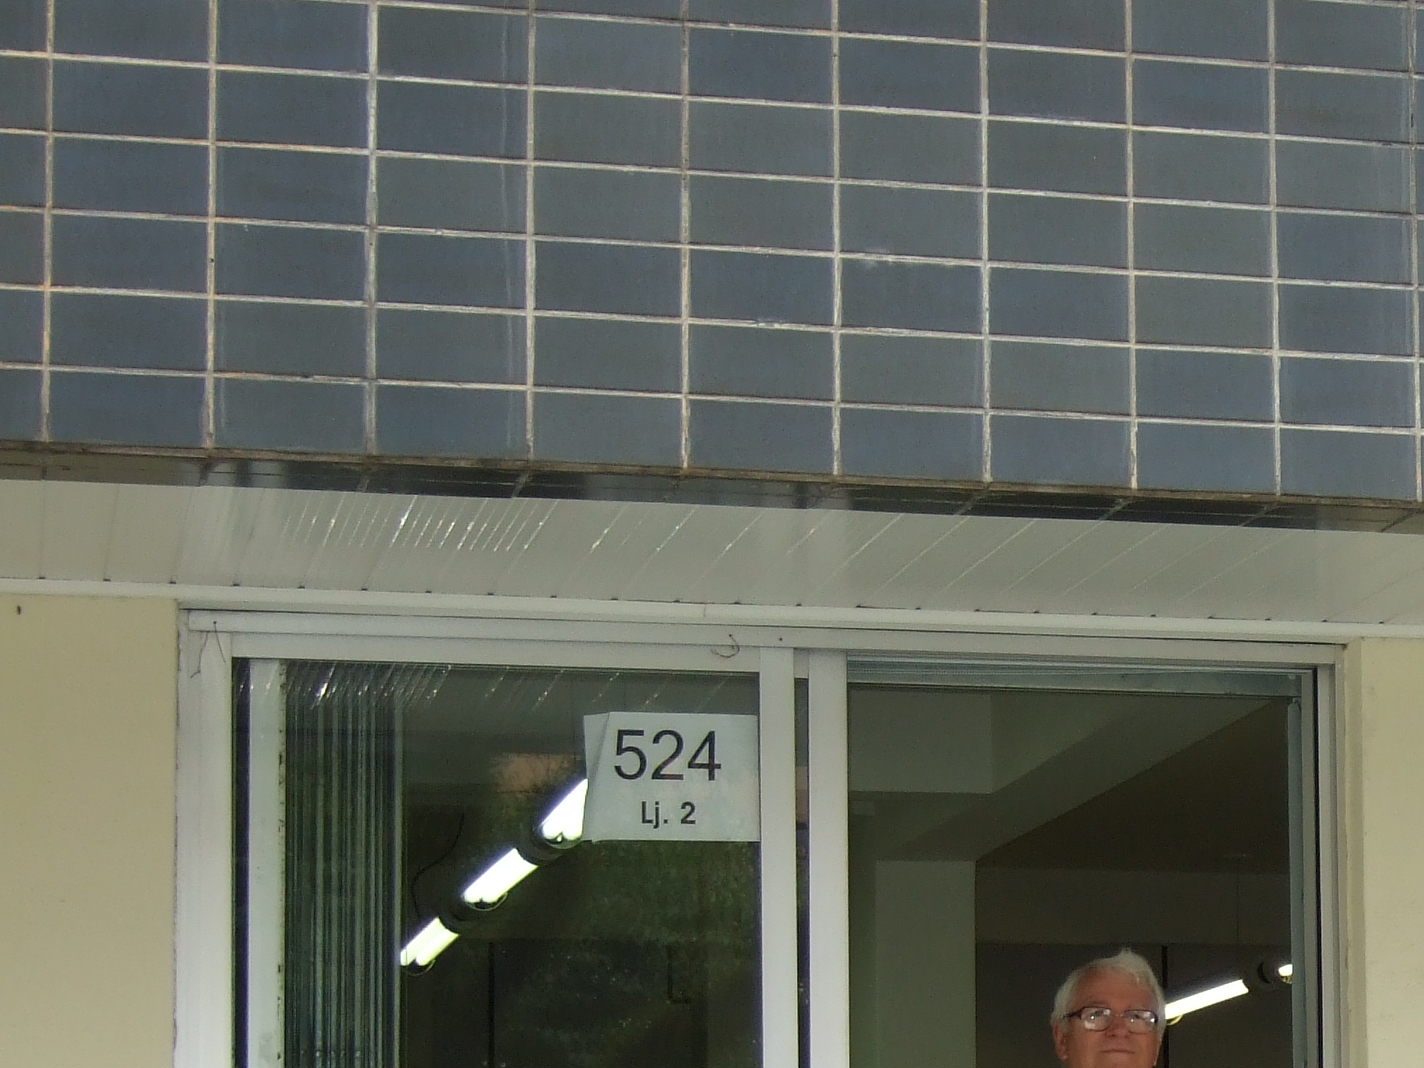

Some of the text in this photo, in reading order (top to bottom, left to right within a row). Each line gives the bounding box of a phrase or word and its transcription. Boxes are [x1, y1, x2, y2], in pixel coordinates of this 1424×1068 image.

[615, 729, 722, 781] 524
[641, 801, 696, 829] Lj. 2
